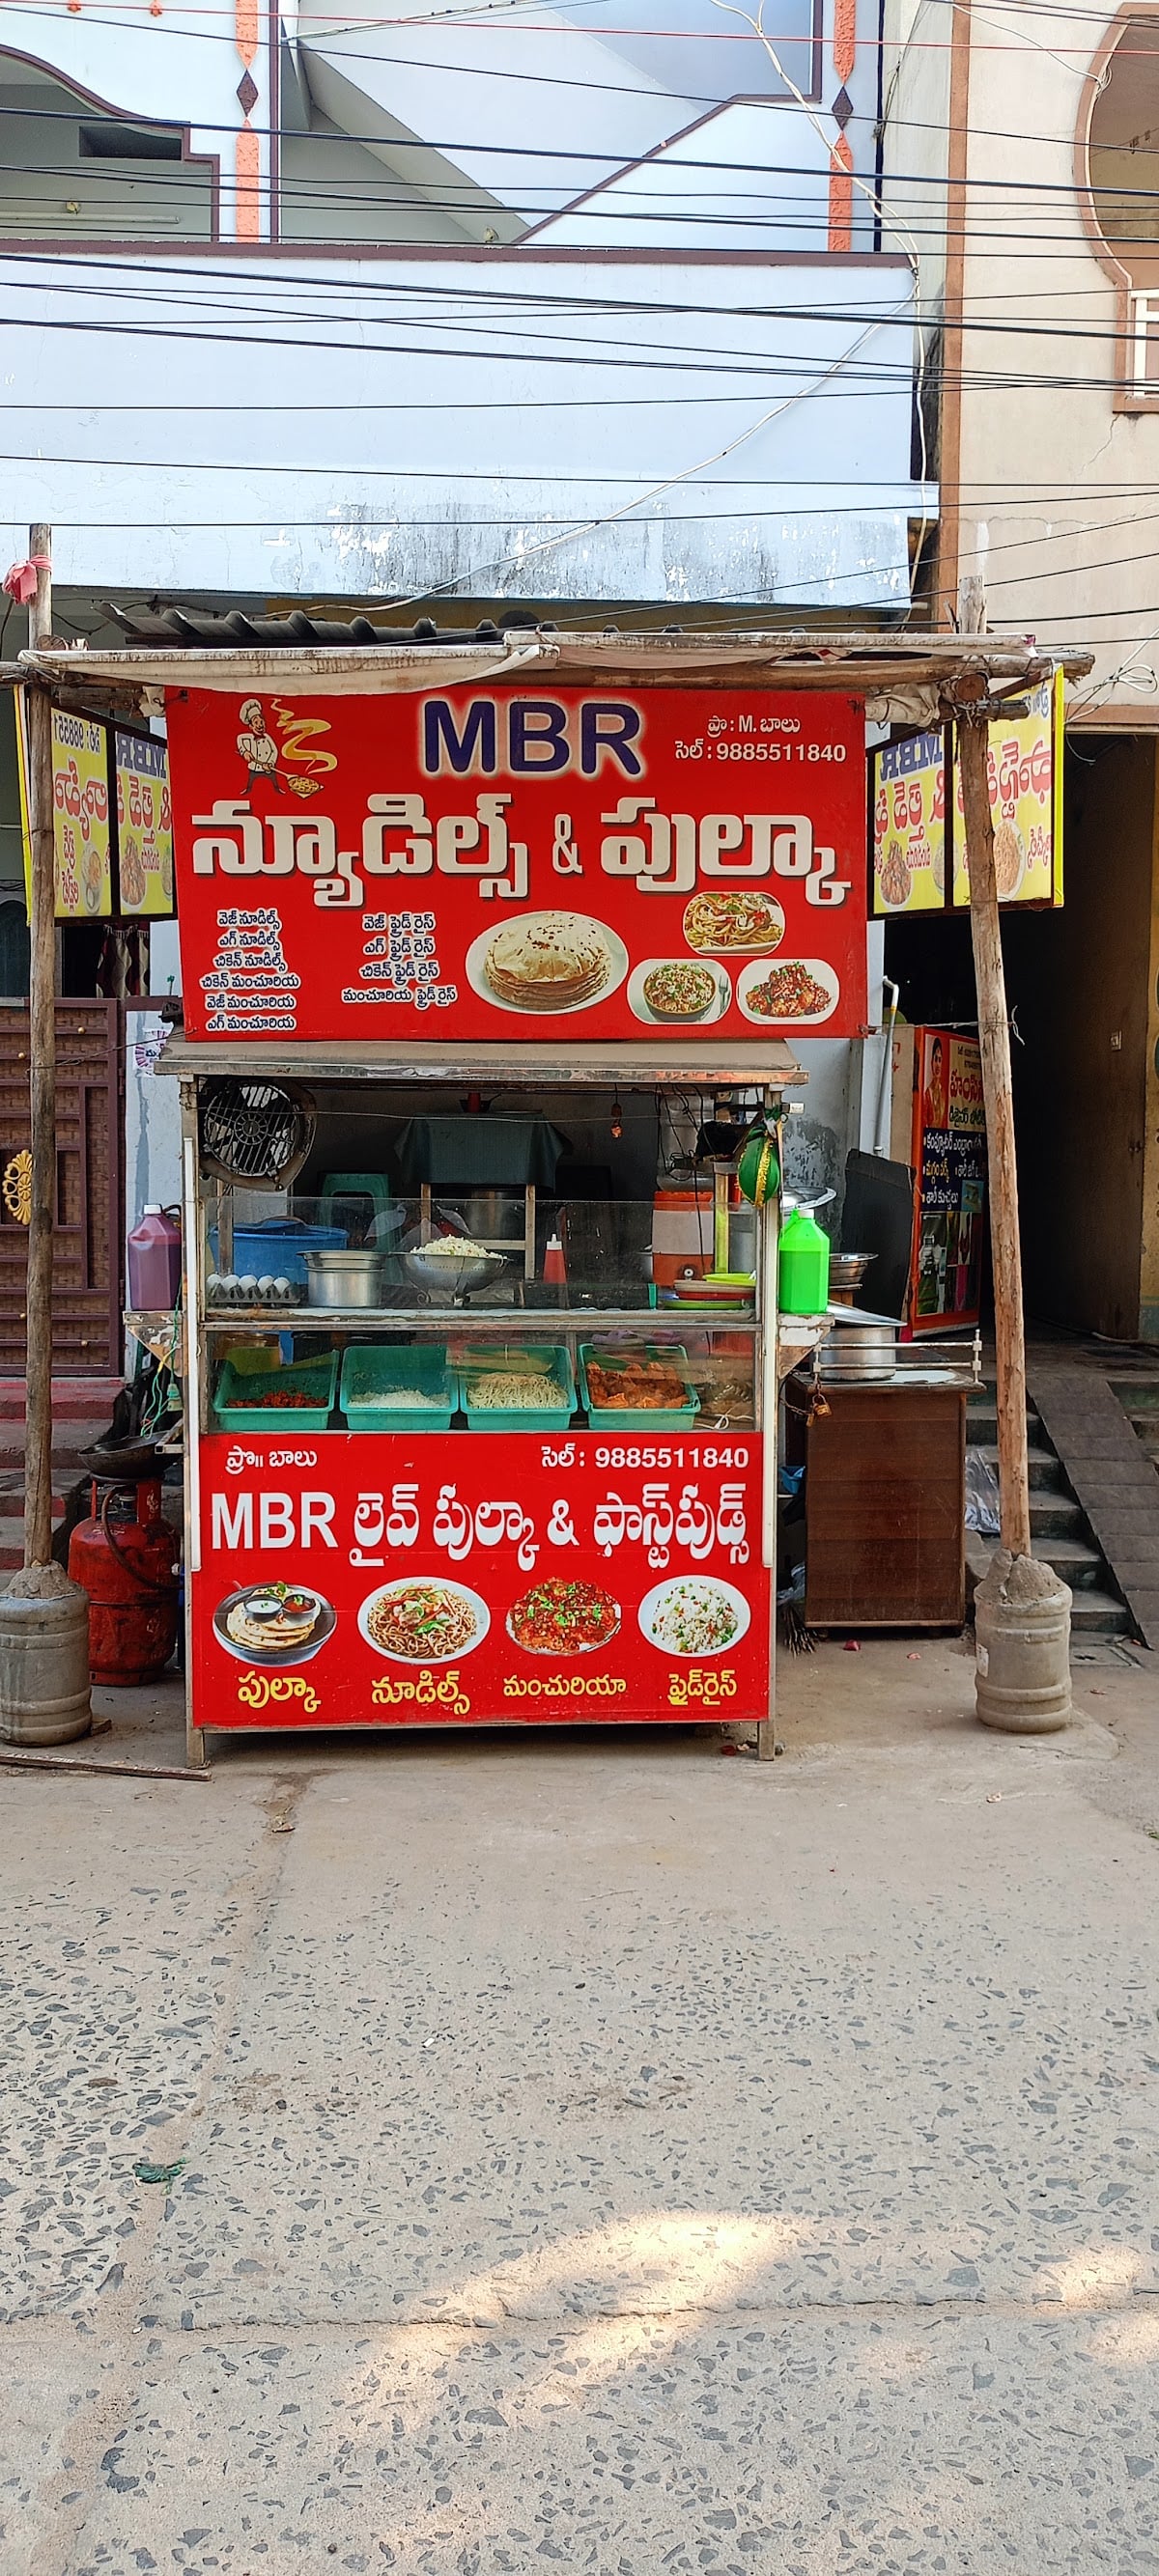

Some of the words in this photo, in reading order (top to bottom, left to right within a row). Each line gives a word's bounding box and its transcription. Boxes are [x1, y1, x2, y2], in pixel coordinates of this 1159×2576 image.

[739, 715, 756, 733] M.
[760, 717, 801, 734] బాలు
[423, 700, 641, 775] MBR
[716, 742, 846, 762] 9885511840
[191, 794, 529, 908] న్యూడిల్స్
[552, 813, 582, 875] &
[601, 797, 852, 907] పుల్కా
[218, 910, 238, 925] వెజ్
[240, 910, 280, 930] నూడిల్స్
[364, 914, 384, 929] వెజ్
[413, 914, 434, 934] రైస్
[220, 931, 237, 945] ఎగ్
[240, 931, 280, 951] నూడిల్స్
[365, 938, 384, 953] ఎగ్
[413, 938, 434, 958] రైస్
[214, 952, 242, 966] చికెన్
[245, 952, 285, 971] నూడిల్స్
[201, 972, 229, 988] చికెన్
[360, 962, 392, 977] చికెన్
[418, 962, 438, 982] రైస్
[207, 994, 225, 1008] వెజ్
[438, 987, 456, 1005] రైస్
[208, 1015, 225, 1029] ఎగ్
[269, 1450, 317, 1467] బాలు
[595, 1447, 749, 1469] 9885511840
[212, 1492, 338, 1551] MBR
[349, 1483, 419, 1567] లైవ్
[433, 1483, 541, 1572] పుల్కా
[548, 1498, 580, 1546] &
[238, 1670, 322, 1713] పుల్కా
[371, 1669, 470, 1715] నూడిల్స్
